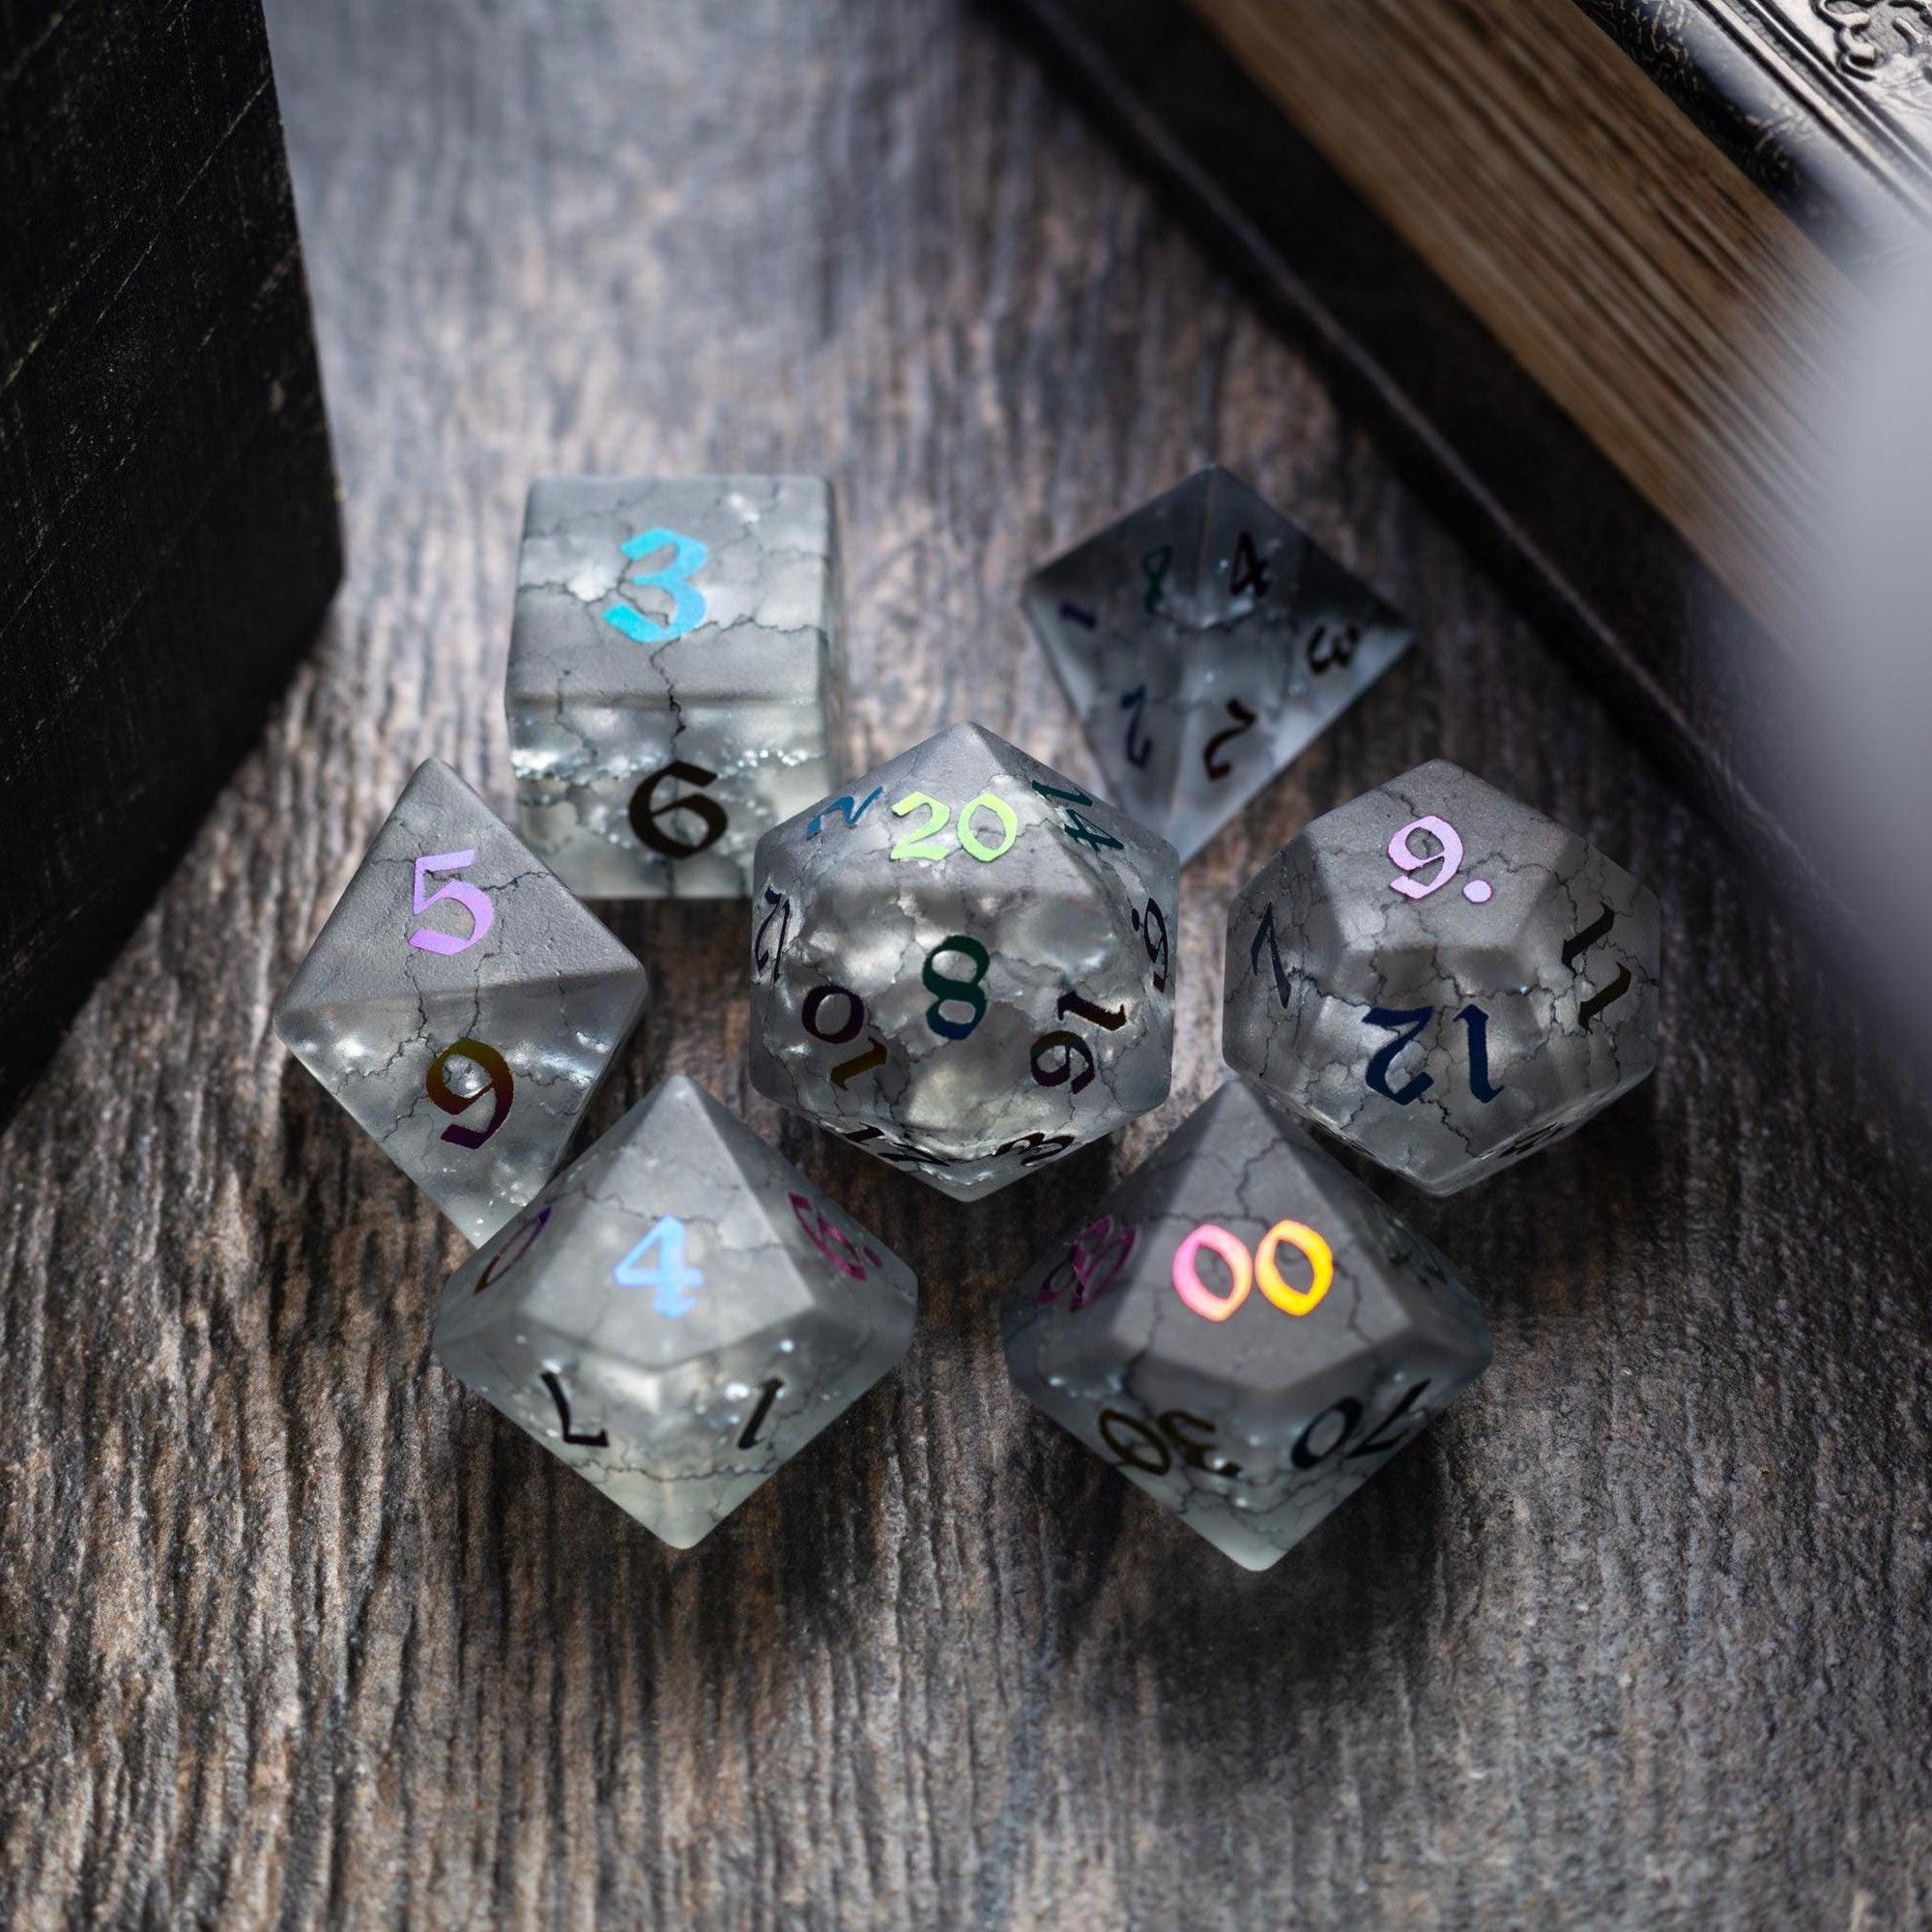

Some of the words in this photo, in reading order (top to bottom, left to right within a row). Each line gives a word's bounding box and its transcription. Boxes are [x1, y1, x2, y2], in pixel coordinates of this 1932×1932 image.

[602, 526, 707, 644] 3
[1229, 531, 1271, 597] 4
[1307, 623, 1359, 675] 3
[1204, 698, 1254, 781] 2
[628, 761, 728, 860] 6
[889, 791, 1018, 862] 20
[1031, 780, 1124, 851] 14
[1388, 815, 1493, 904] 9.
[408, 849, 494, 956] 5
[801, 984, 888, 1091] 10
[921, 935, 990, 1041] 8
[425, 1036, 514, 1149] 9
[1029, 989, 1126, 1094] 16
[1361, 1003, 1506, 1106] 12
[613, 1215, 704, 1319] 4
[1172, 1219, 1334, 1322] 00
[737, 1375, 784, 1450] 1
